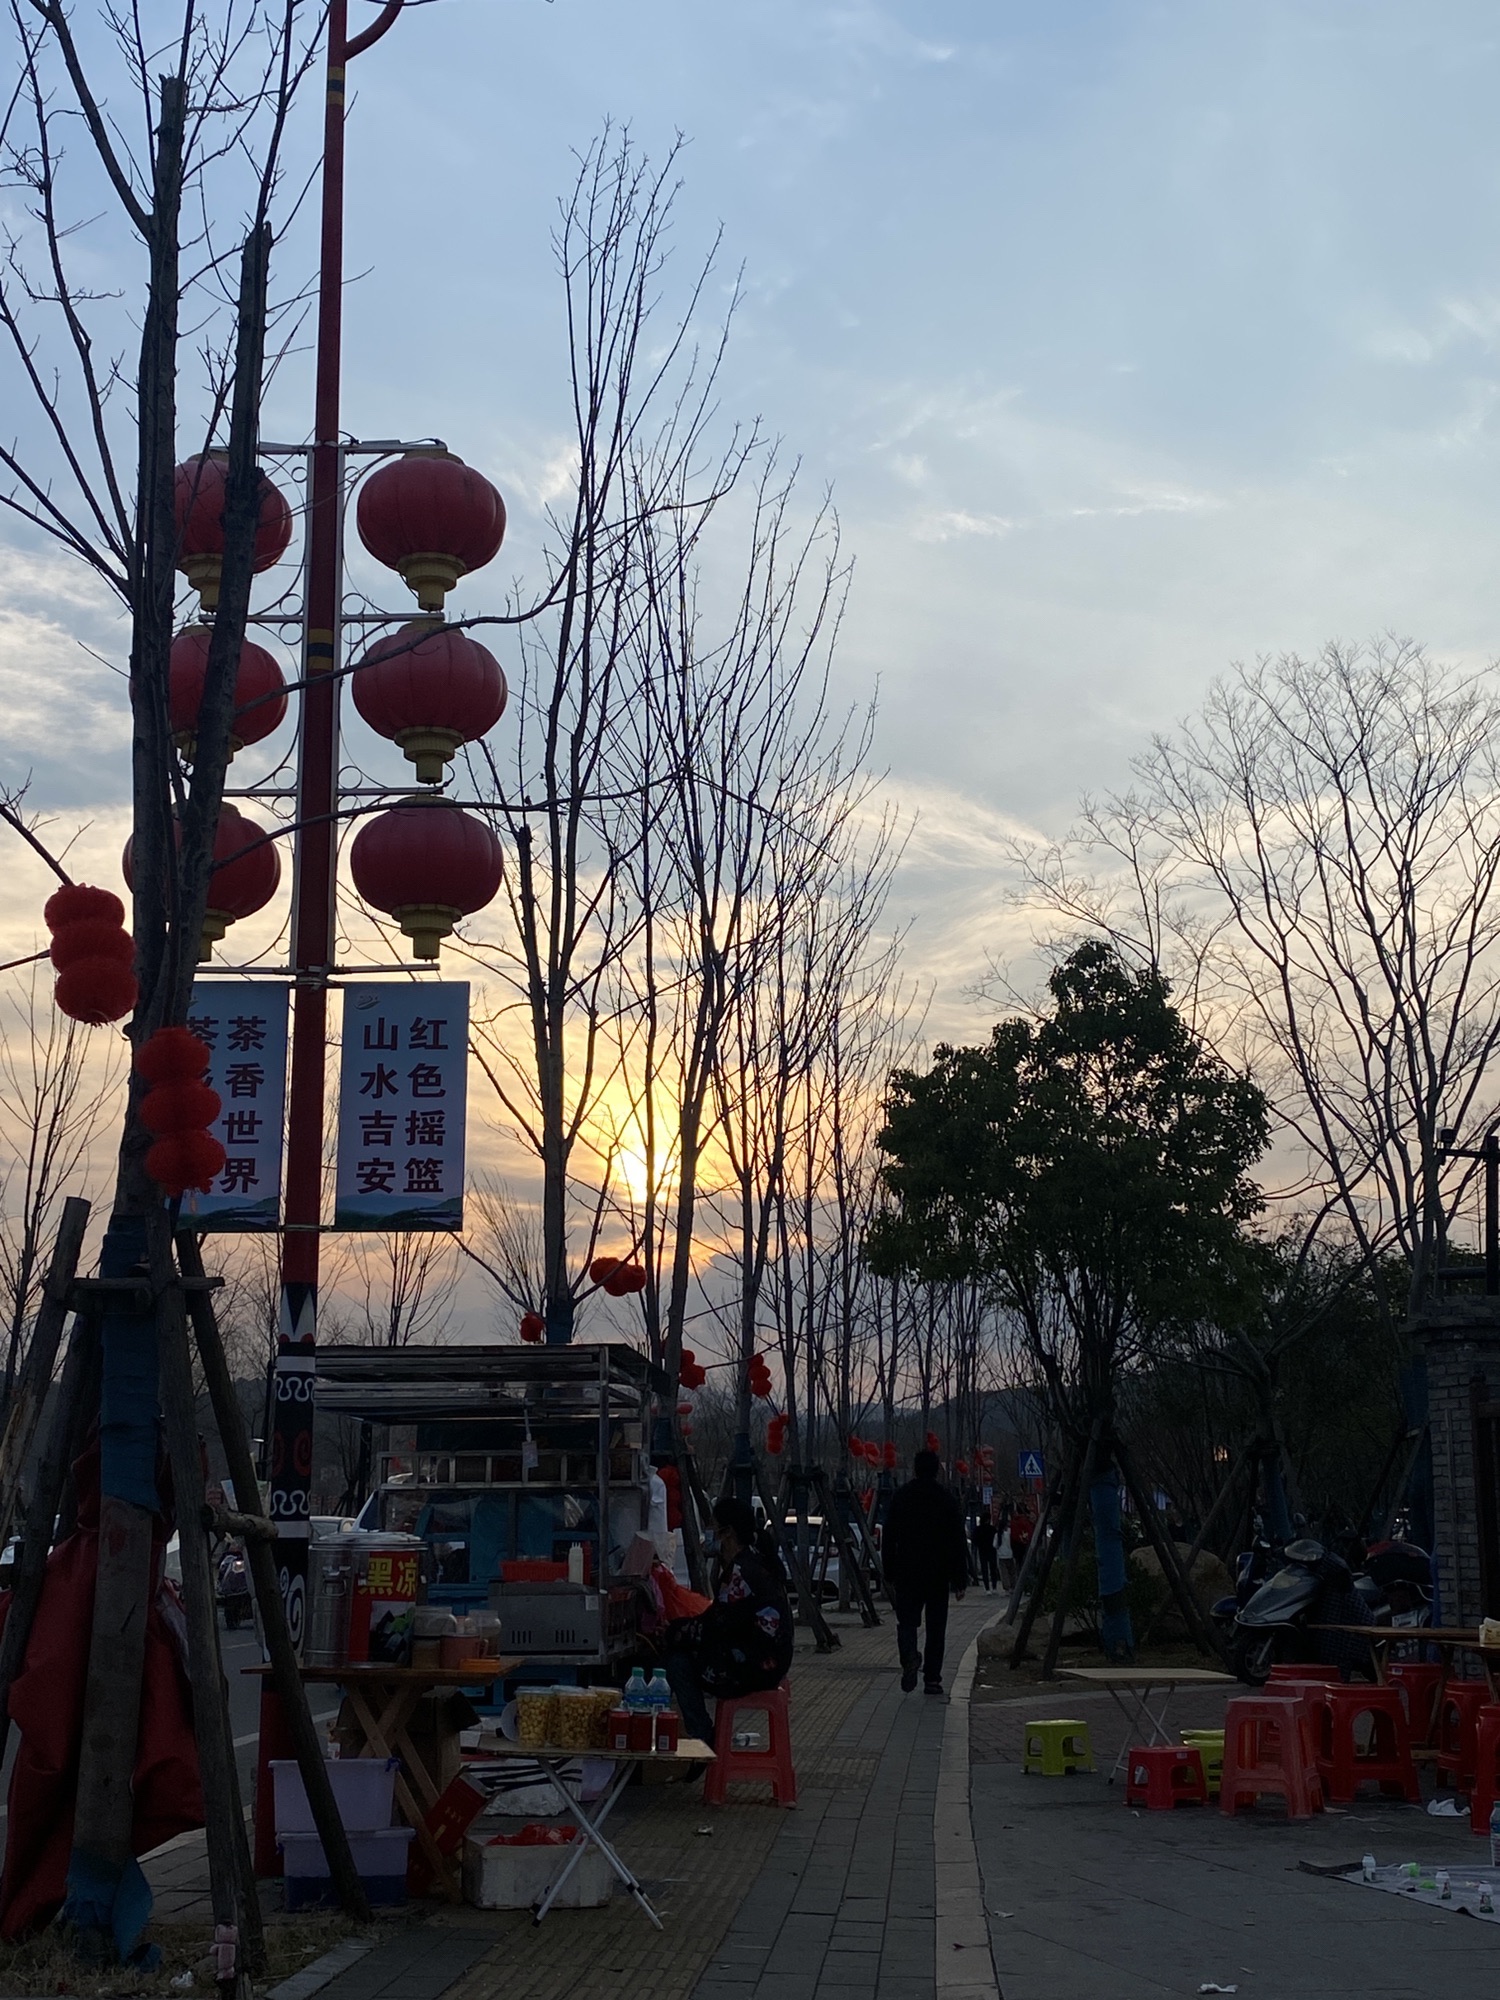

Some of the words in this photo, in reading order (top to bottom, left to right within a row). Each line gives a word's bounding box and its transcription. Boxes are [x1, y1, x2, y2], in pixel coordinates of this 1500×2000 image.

[219, 1015, 267, 1194] 茶香世界
[356, 1017, 400, 1194] 山水吉安
[403, 1017, 449, 1193] 红色摇篮
